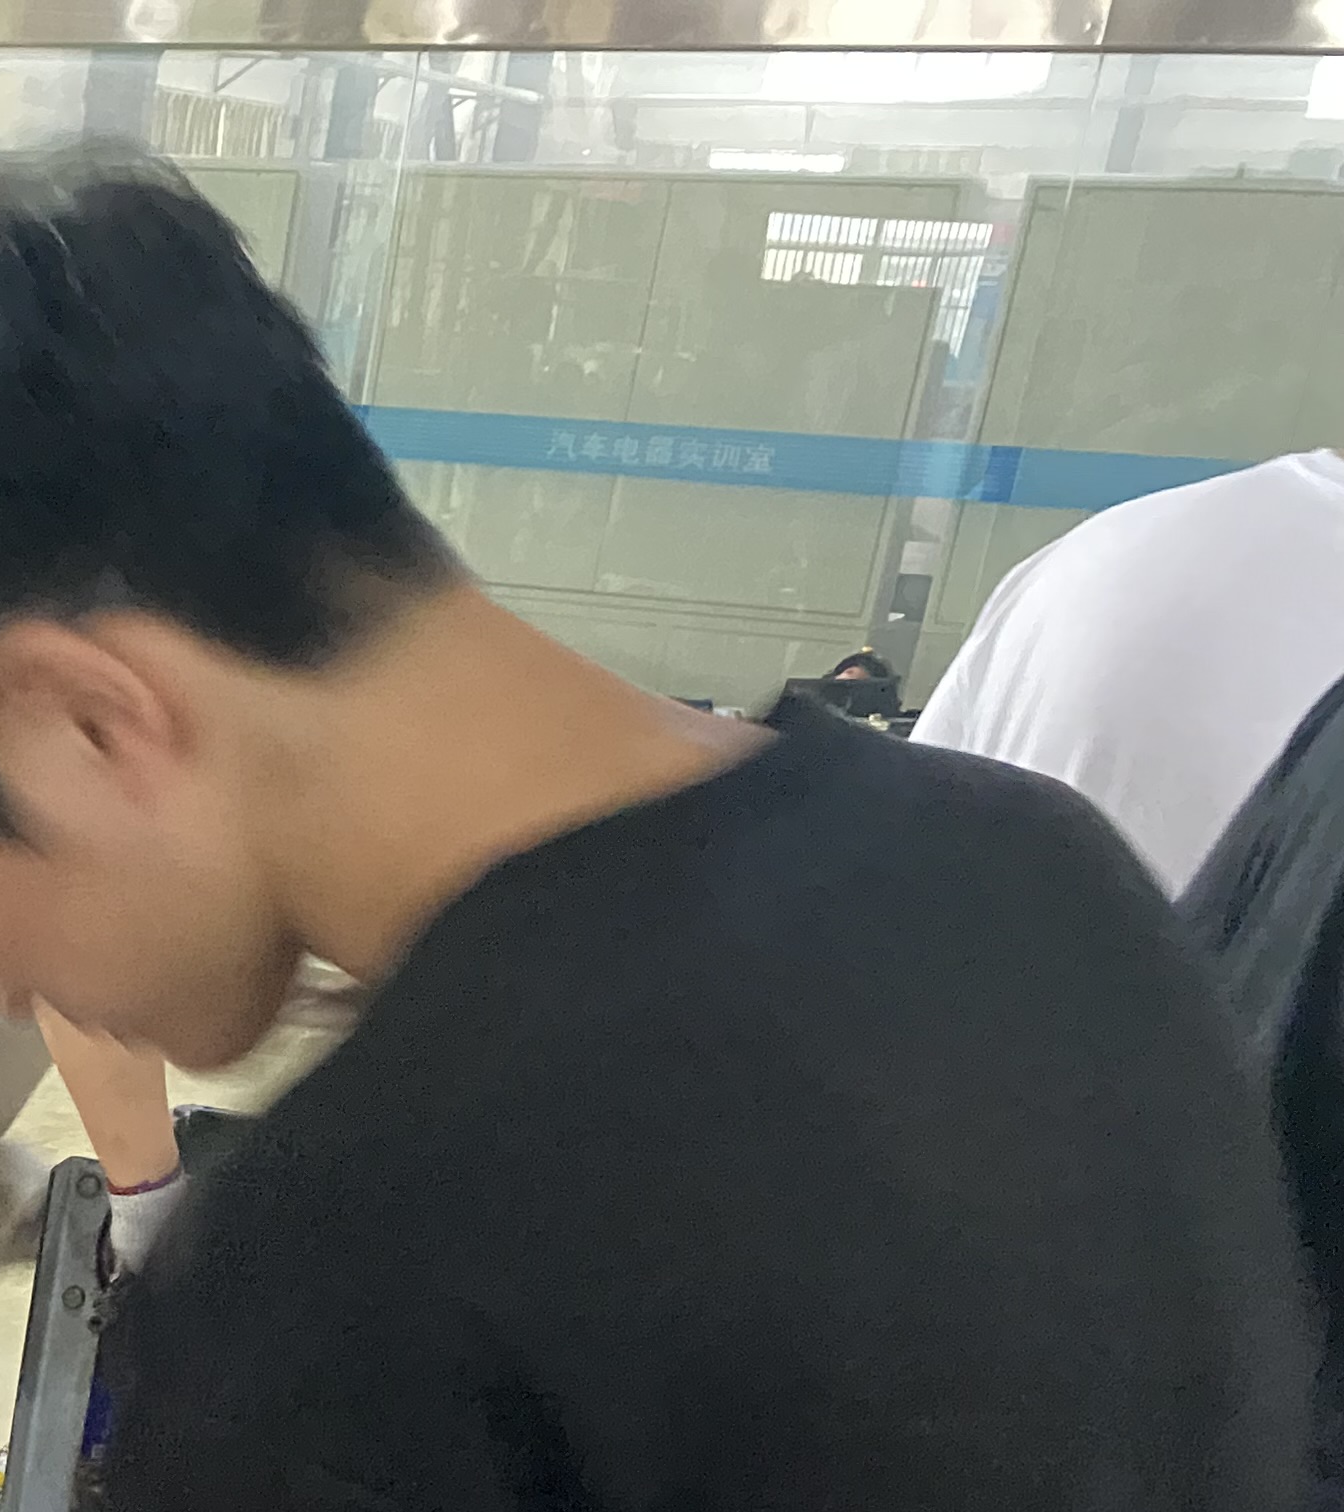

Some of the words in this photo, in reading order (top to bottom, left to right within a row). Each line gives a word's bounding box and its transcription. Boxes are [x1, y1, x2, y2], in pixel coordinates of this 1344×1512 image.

[547, 429, 776, 474] 汽车电器实训室
